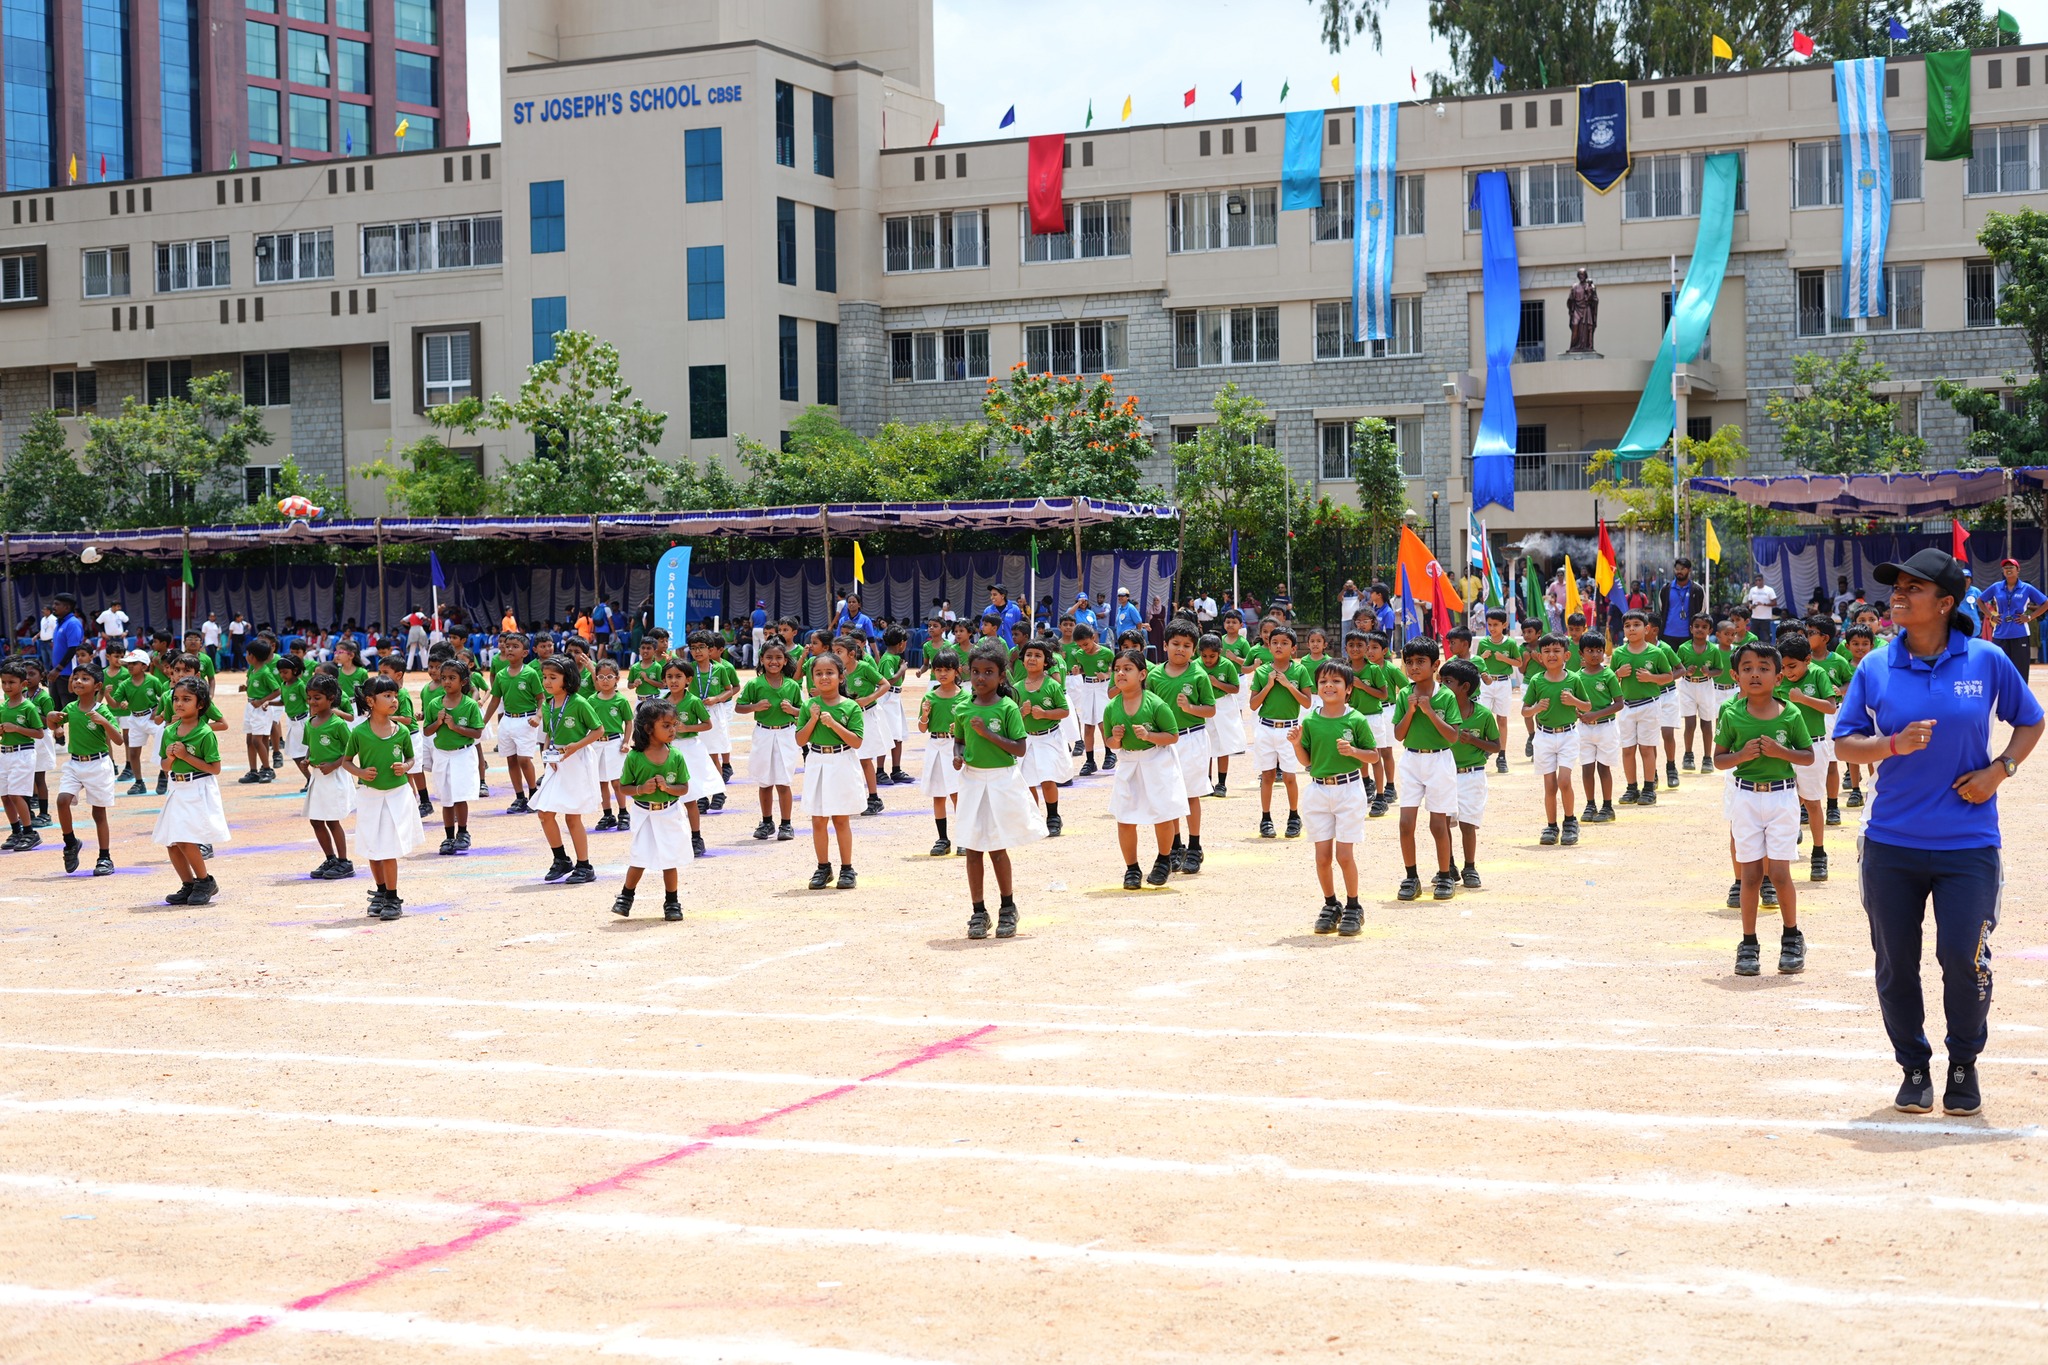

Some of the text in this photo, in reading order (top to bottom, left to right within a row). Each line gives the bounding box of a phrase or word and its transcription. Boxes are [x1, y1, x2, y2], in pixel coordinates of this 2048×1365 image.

[514, 102, 535, 124] ST
[630, 84, 701, 112] SCHOOL
[708, 85, 742, 104] CBSE
[688, 588, 721, 600] APPHIRE
[690, 599, 713, 608] HOUSE
[667, 572, 676, 649] SAPPHIRE
